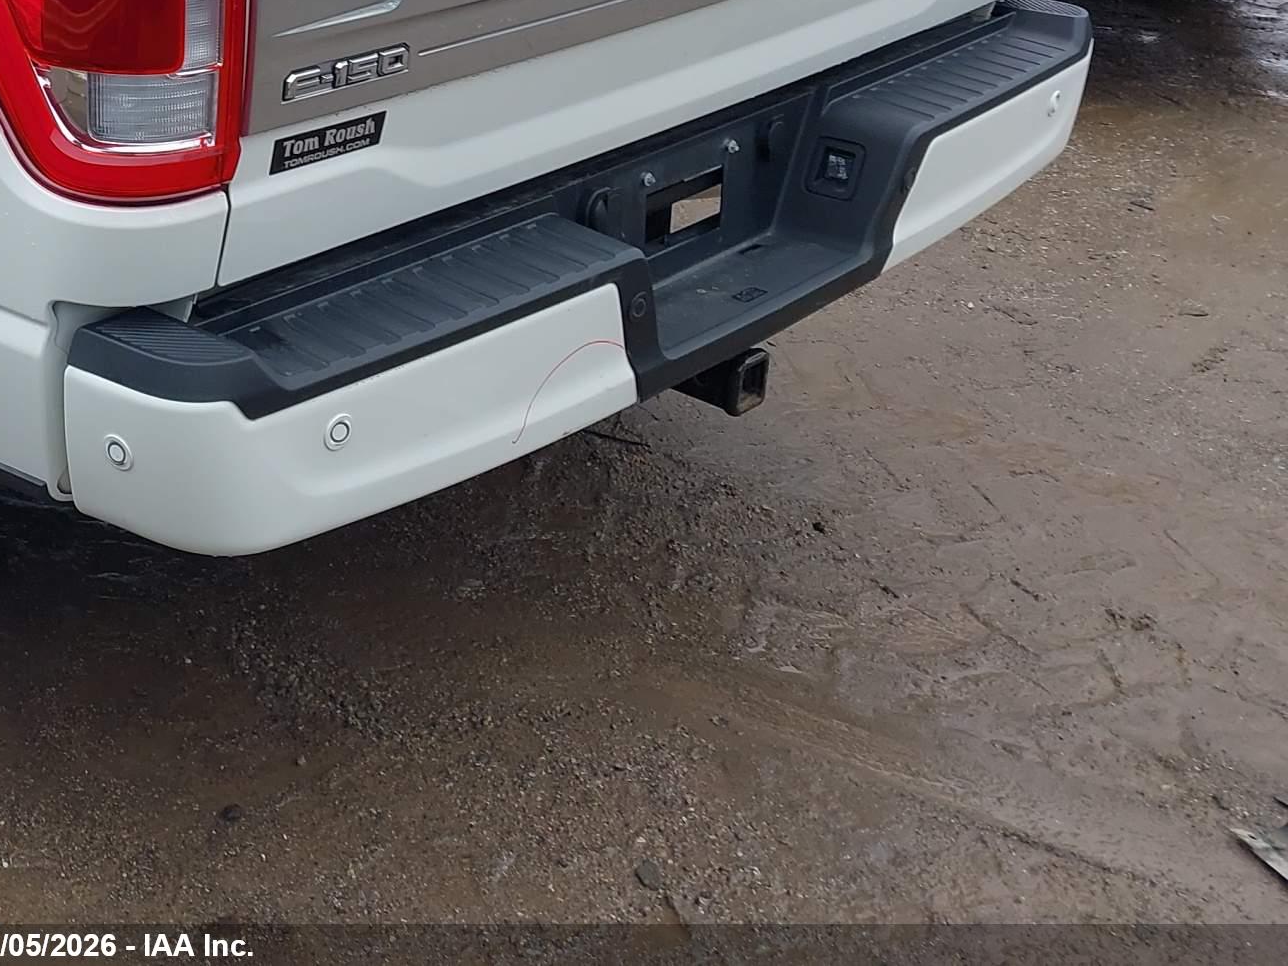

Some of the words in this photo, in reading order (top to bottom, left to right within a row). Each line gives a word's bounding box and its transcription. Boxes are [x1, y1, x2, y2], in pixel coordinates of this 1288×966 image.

[282, 43, 410, 103] F-150
[283, 135, 320, 158] Tom
[324, 117, 376, 147] Roush
[283, 138, 371, 169] TOMROUSH.COM
